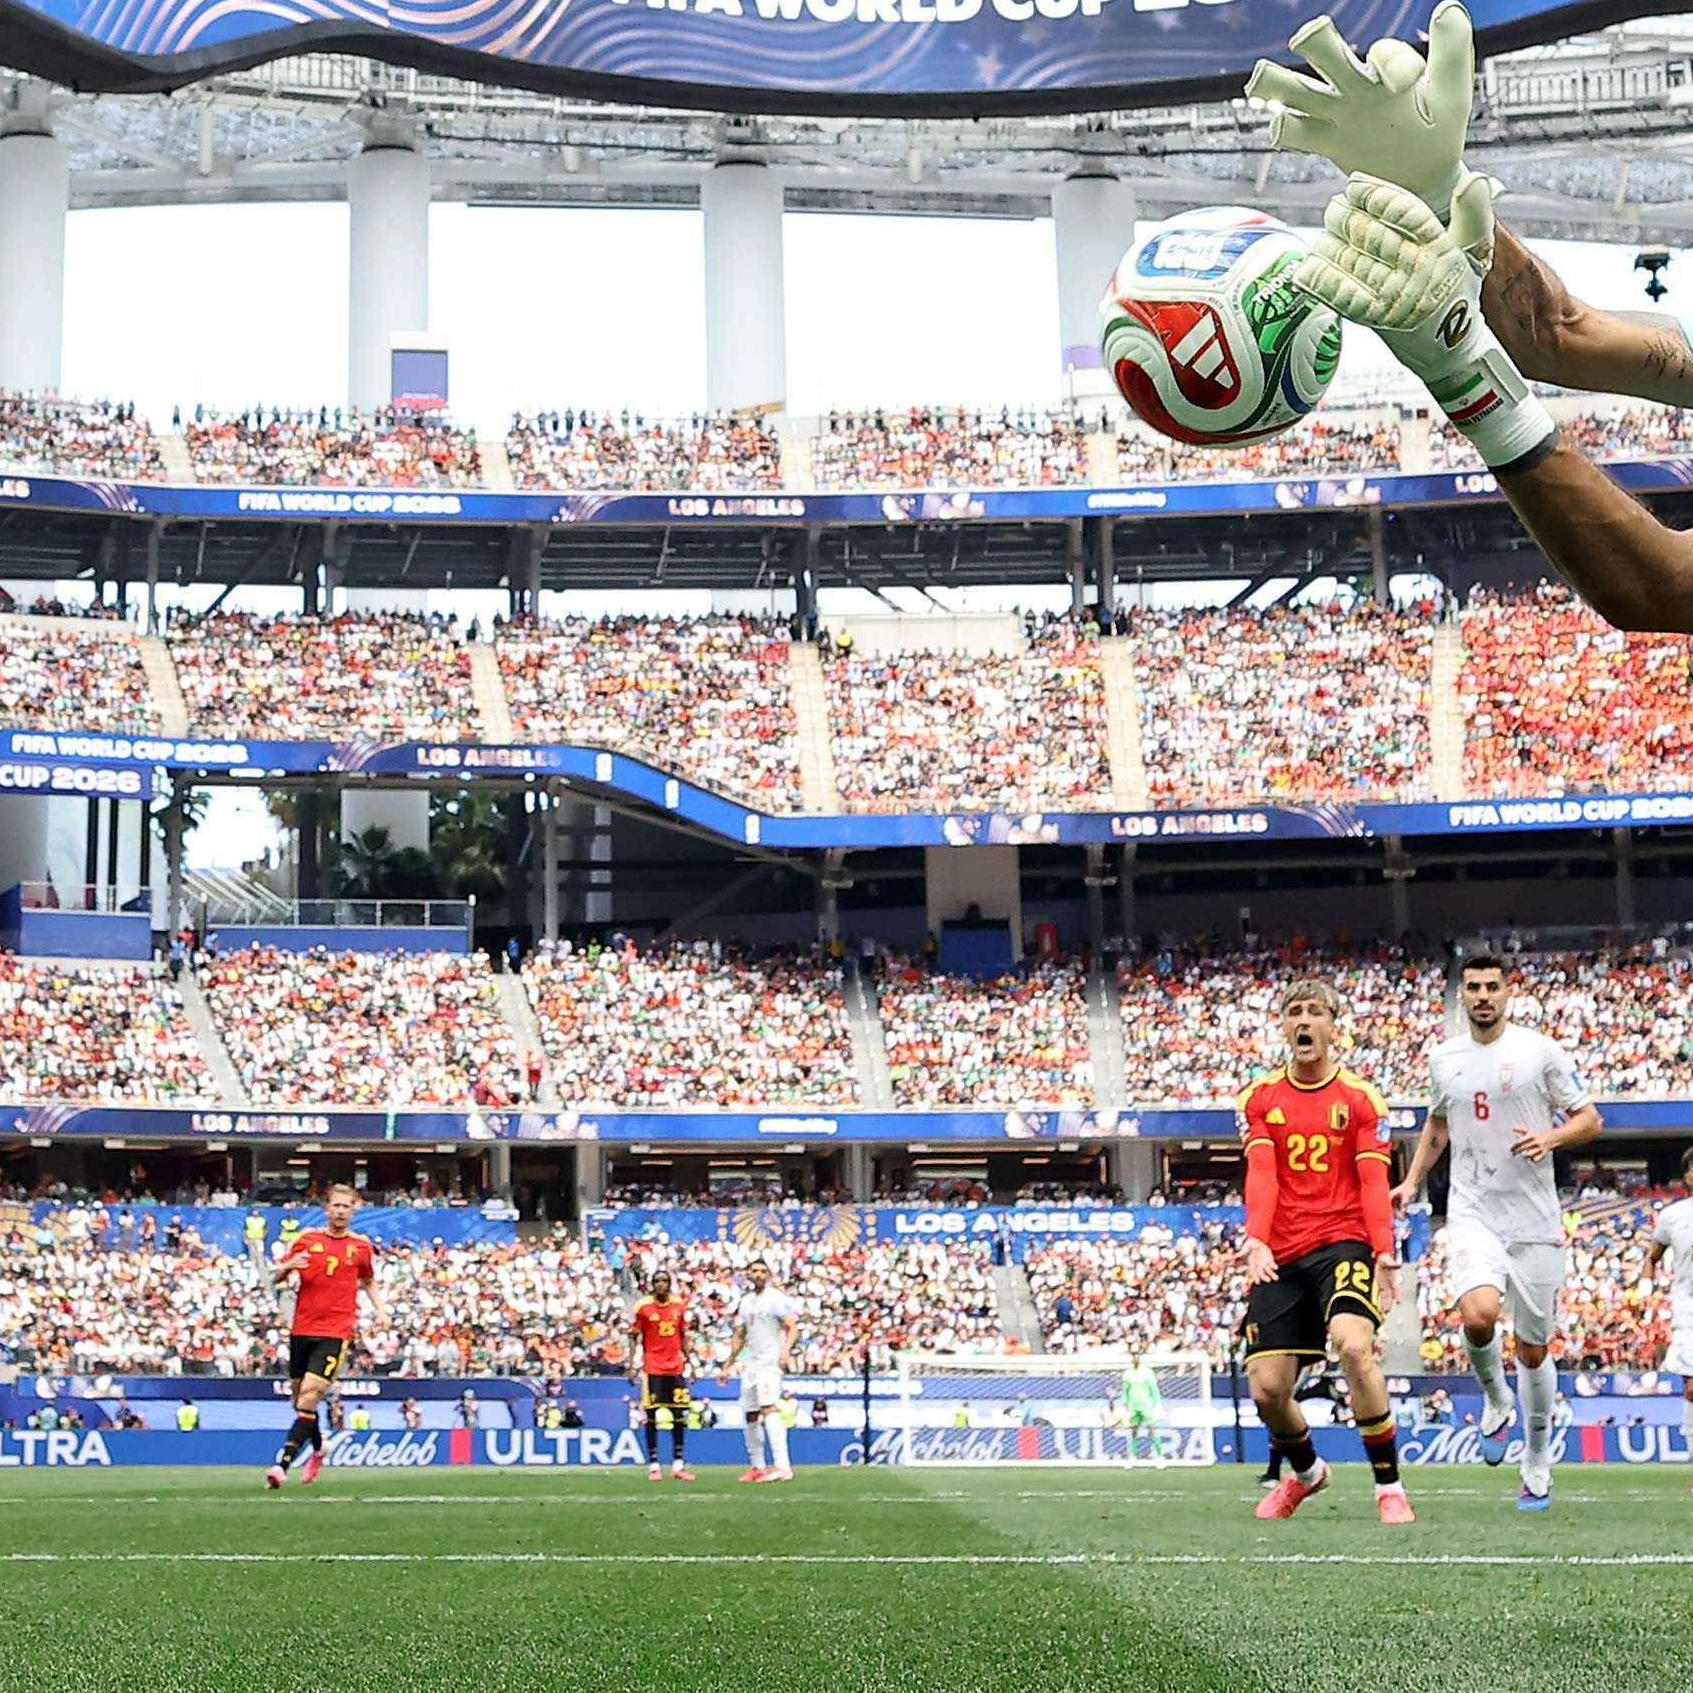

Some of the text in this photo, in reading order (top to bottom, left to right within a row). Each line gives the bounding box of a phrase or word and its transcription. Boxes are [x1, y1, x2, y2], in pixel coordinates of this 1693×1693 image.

[668, 498, 709, 516] LOS
[12, 734, 57, 754] FIFA
[58, 736, 131, 759] WORLD
[132, 740, 174, 761] CUP
[417, 748, 461, 766] LOS
[50, 768, 140, 793] 2026
[1112, 813, 1268, 835] LOS ANGELES
[1450, 806, 1499, 827] FIFA
[1501, 803, 1582, 824] WORLD
[1584, 799, 1630, 821] CUP
[1474, 1091, 1489, 1120] 6
[192, 1114, 232, 1132] LOS
[1287, 1134, 1329, 1172] 22
[896, 1213, 966, 1233] LOS
[326, 1255, 339, 1276] 7
[324, 1355, 337, 1377] 7
[485, 1428, 646, 1466] ULTRA
